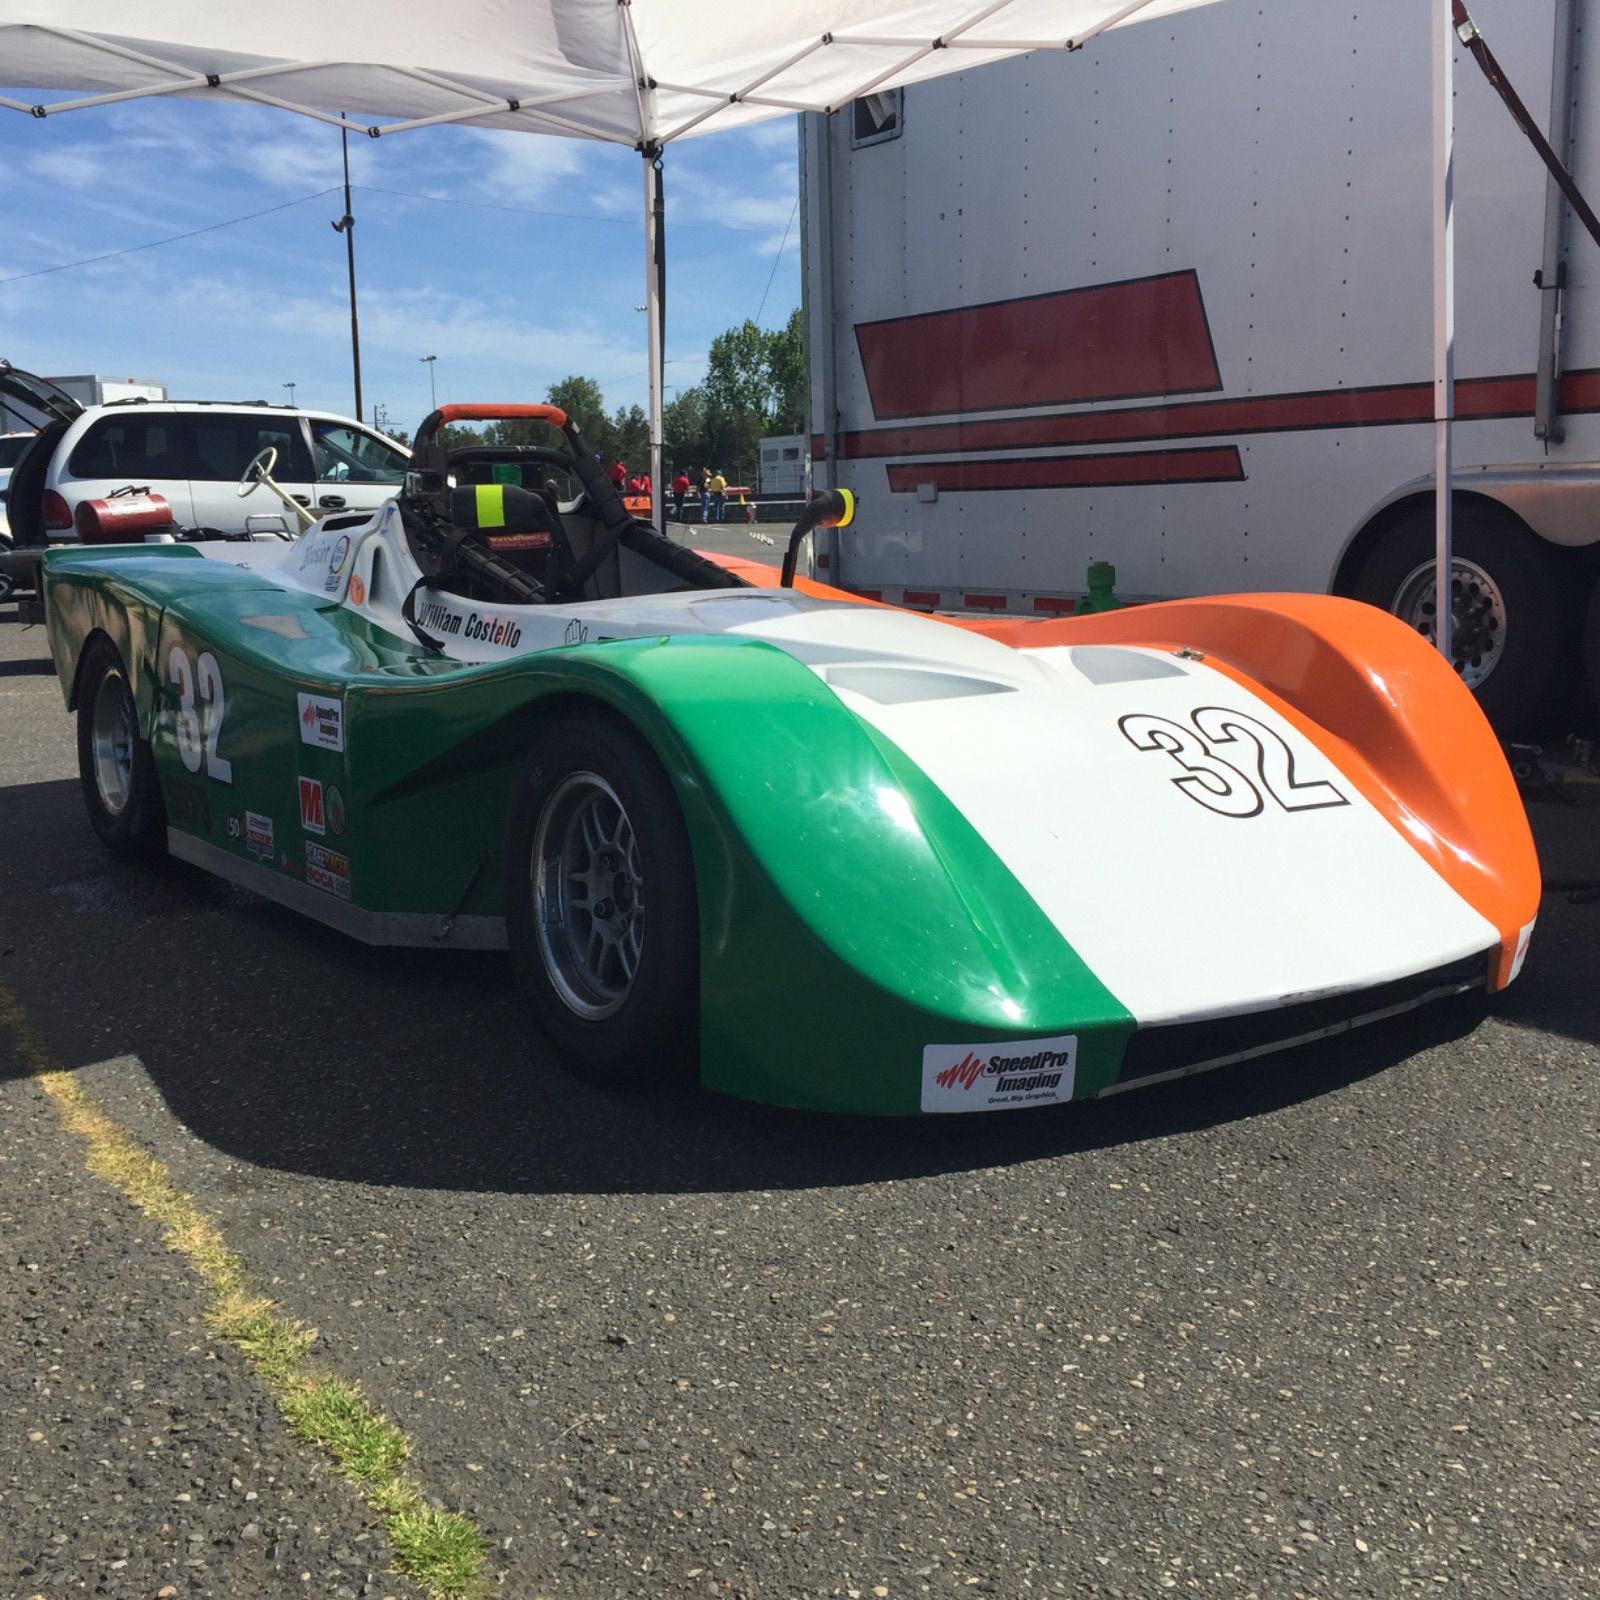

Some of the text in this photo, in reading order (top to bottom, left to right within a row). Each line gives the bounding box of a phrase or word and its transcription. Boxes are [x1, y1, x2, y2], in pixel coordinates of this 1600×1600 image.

[416, 602, 521, 648] William Costello
[169, 647, 232, 784] 32
[1118, 706, 1352, 818] 32
[986, 1051, 1068, 1074] SpeedPro
[995, 1072, 1061, 1093] Imaging
